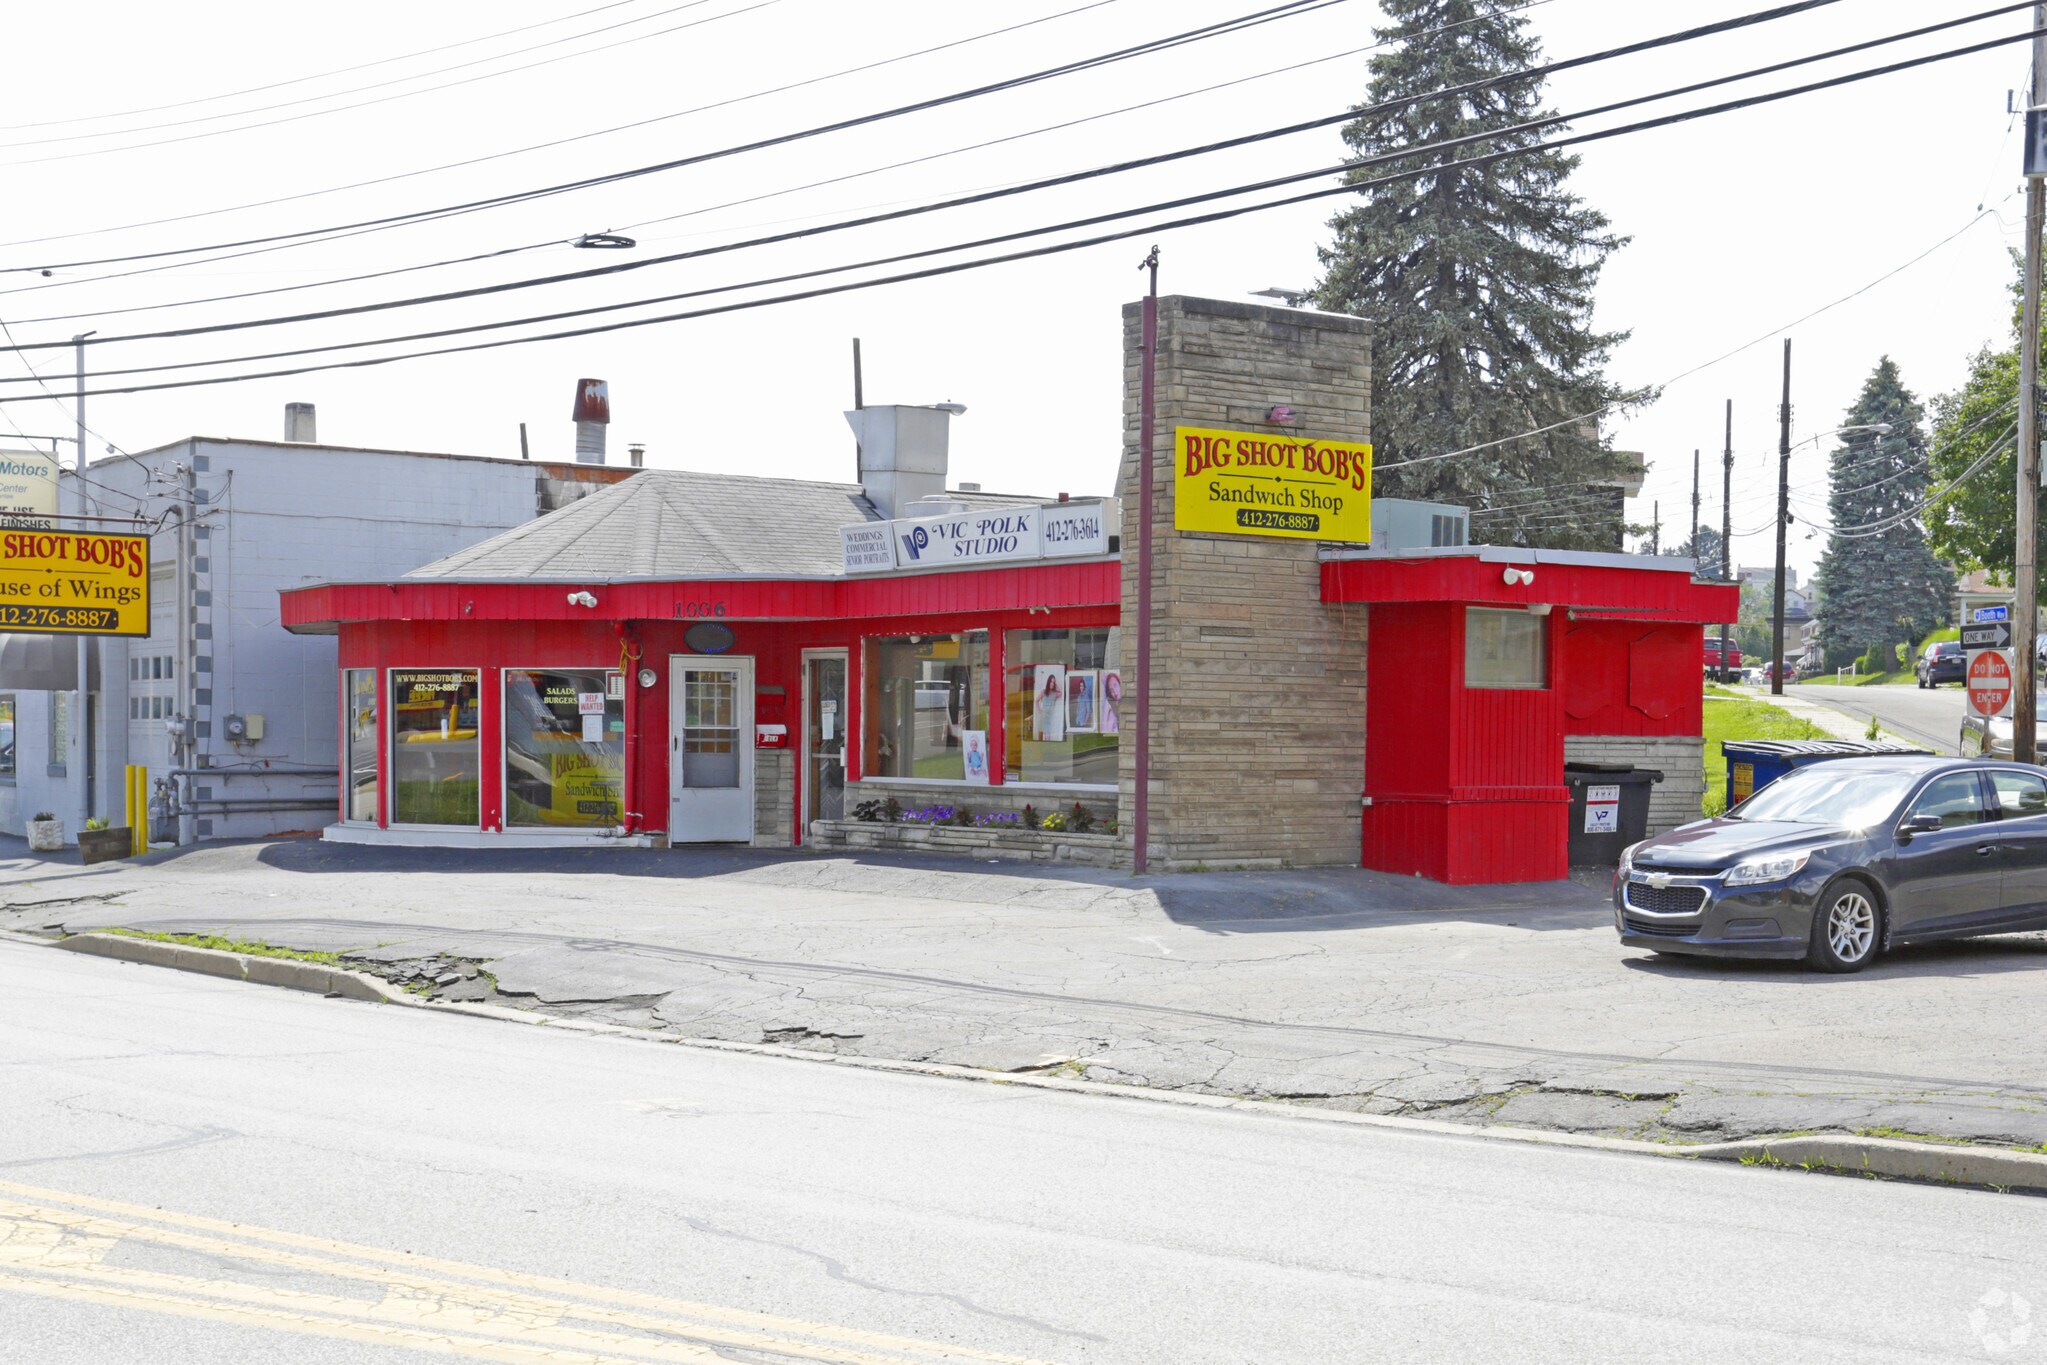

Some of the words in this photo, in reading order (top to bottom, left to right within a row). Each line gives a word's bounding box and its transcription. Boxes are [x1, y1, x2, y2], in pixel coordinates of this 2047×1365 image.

[1184, 435, 1231, 477] BIG
[1237, 439, 1298, 468] SHOT
[1302, 444, 1365, 491] BOB'S
[1209, 481, 1295, 507] Sandwich
[1300, 488, 1344, 515] Shop
[931, 521, 968, 539] VIC
[976, 514, 1030, 536] POLK
[1241, 514, 1315, 530] 412-276-8887
[846, 530, 884, 542] WEDDINGS
[1045, 517, 1100, 542] 412-276-3614
[846, 541, 888, 554] COMMERCIAL
[953, 535, 1018, 557] STUDIO
[4, 533, 70, 560] SHOT
[75, 535, 143, 578] BOB'S
[38, 578, 62, 597] of
[68, 579, 141, 605] Wings
[675, 601, 726, 619] 1006
[1965, 632, 1979, 643] ONE
[1981, 630, 1995, 641] WAY
[1974, 663, 1986, 674] DO
[1989, 663, 2006, 674] NOT
[413, 683, 459, 692] 412-276-8887
[546, 687, 576, 695] SALADS
[543, 696, 578, 704] BURGERS
[585, 694, 599, 703] HELP
[1976, 692, 2003, 703] ENTER
[580, 703, 604, 712] WANTED
